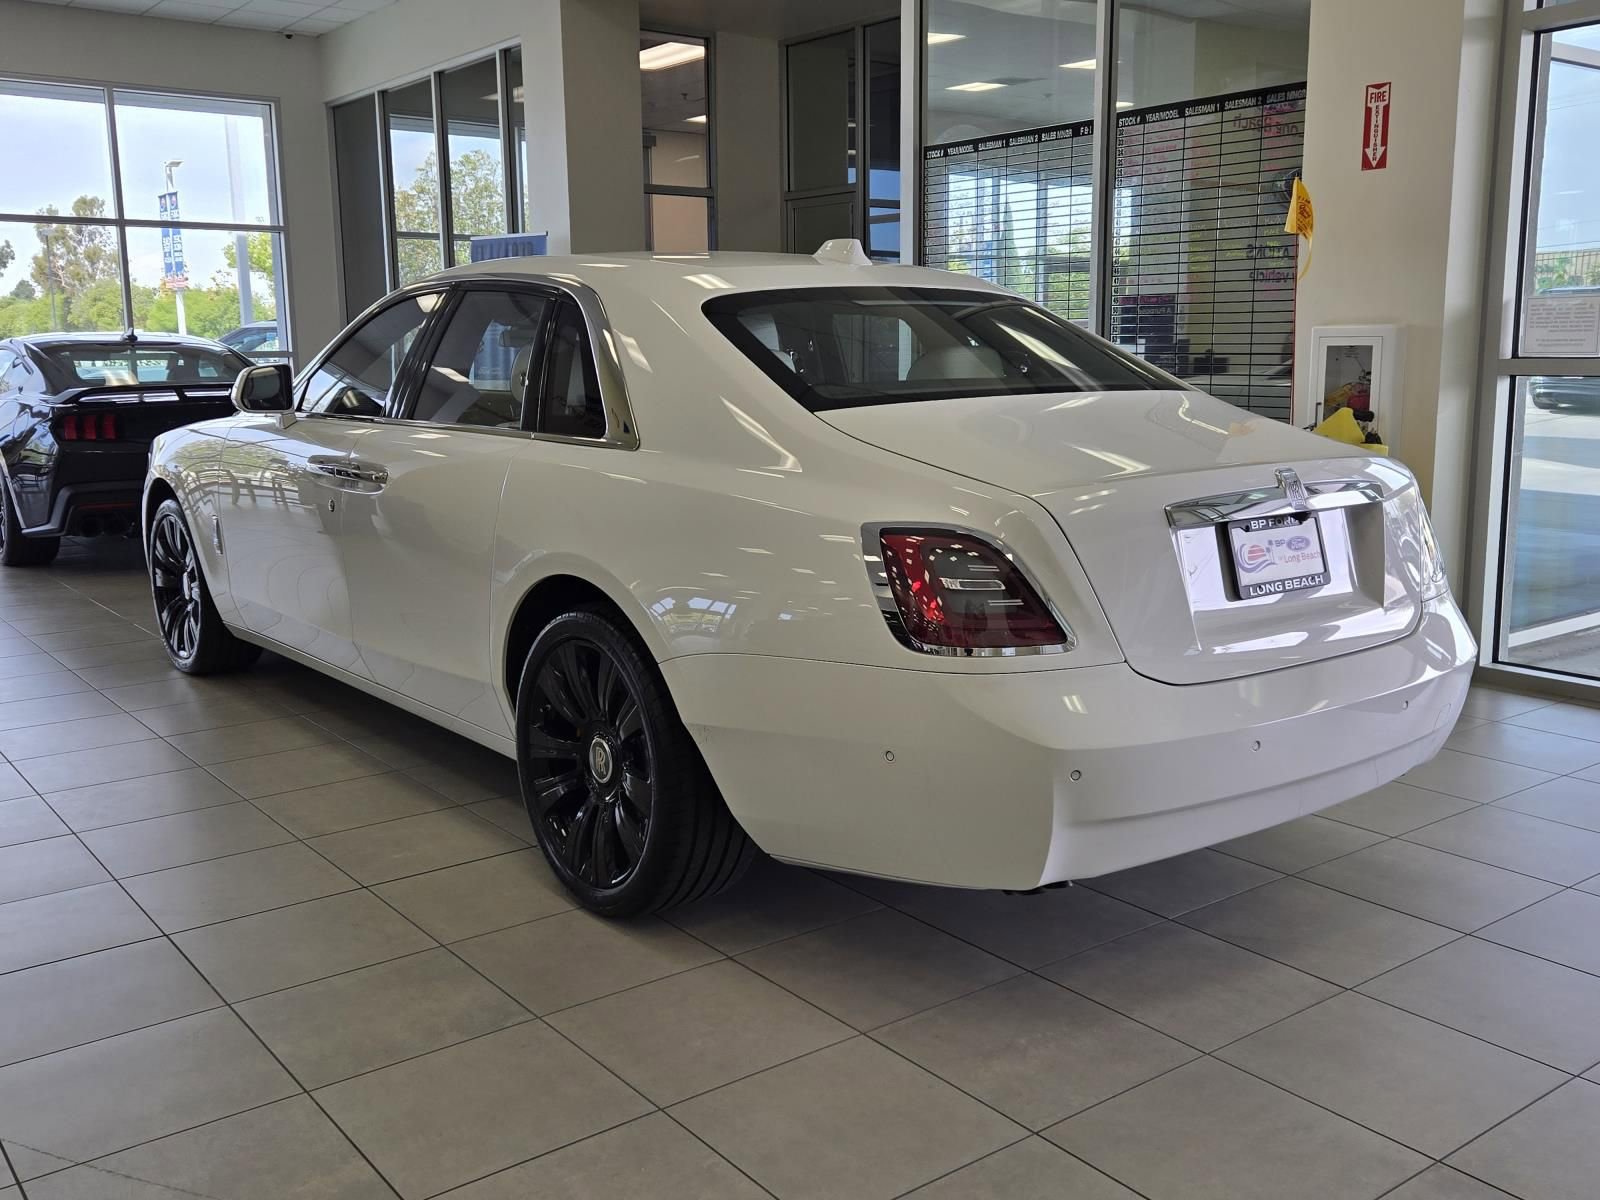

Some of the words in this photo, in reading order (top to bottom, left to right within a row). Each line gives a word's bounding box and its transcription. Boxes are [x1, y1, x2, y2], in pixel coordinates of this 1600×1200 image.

[1369, 90, 1387, 104] FIRE
[1118, 117, 1136, 127] STOCK
[1145, 109, 1180, 123] YEAR/MODEL
[1184, 104, 1215, 116] SALESMAN
[1224, 97, 1256, 110] SALESMAN
[1257, 96, 1262, 105] 2
[1266, 92, 1286, 104] SALES
[926, 150, 941, 159] STOCK
[947, 144, 975, 156] YEAR/MODEL
[978, 139, 1003, 151] SALESMAN
[1008, 134, 1034, 147] SALESMAN
[1041, 130, 1057, 142] SALES
[1371, 104, 1380, 162] EXTINGUISHER
[1250, 519, 1266, 530] BP
[1284, 553, 1301, 563] Long
[1249, 582, 1283, 597] LONG
[1284, 574, 1324, 590] BEACH
